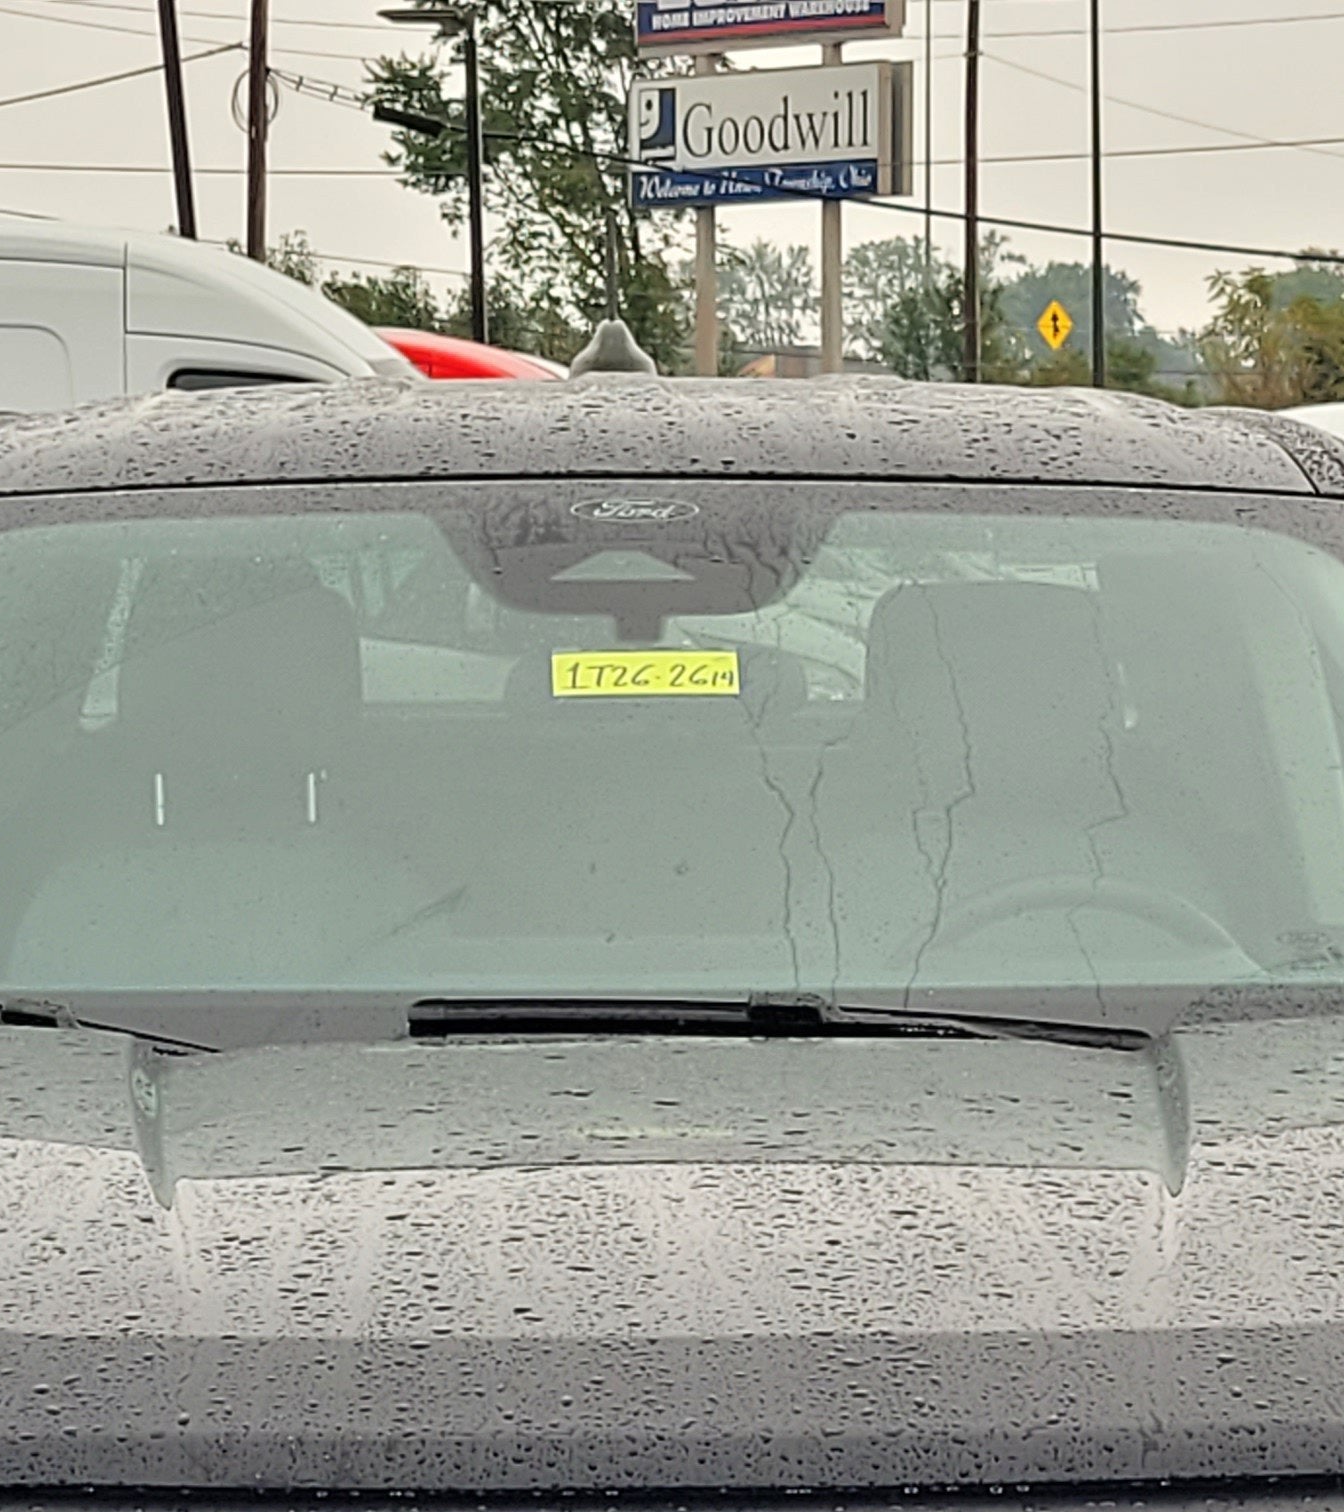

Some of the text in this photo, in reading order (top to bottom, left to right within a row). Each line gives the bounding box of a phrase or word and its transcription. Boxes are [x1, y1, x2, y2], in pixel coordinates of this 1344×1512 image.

[652, 12, 689, 31] HOME
[693, 4, 785, 27] IMPROVEMENT
[788, 0, 870, 18] WAREHOUSE
[682, 89, 870, 158] Goodwill
[703, 180, 716, 196] to
[593, 500, 676, 519] Ford
